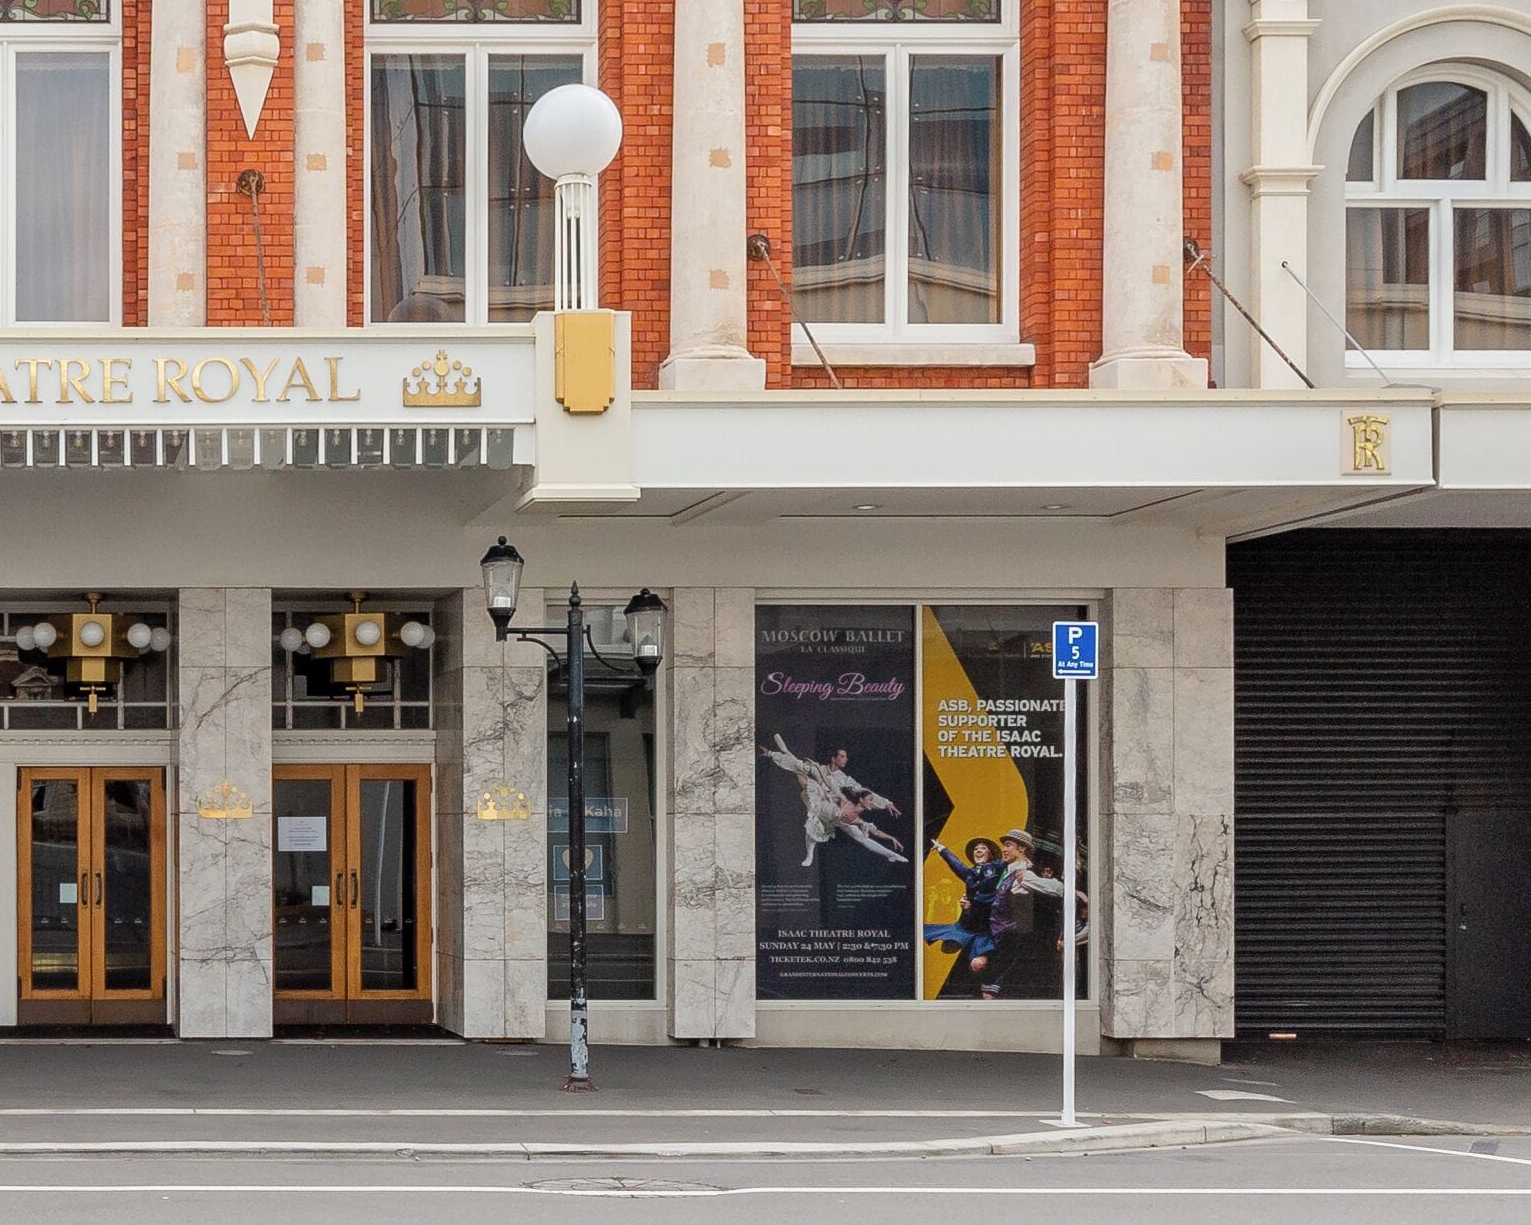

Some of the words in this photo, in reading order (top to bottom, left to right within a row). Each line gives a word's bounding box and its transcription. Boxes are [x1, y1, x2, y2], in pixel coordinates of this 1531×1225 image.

[152, 356, 361, 404] ROYAL
[762, 629, 838, 643] MOSCOW
[845, 629, 905, 643] BALLET
[1068, 626, 1083, 645] P
[800, 645, 813, 653] LA
[1071, 646, 1080, 660] 5
[1057, 660, 1065, 668] At
[1067, 660, 1078, 669] Any
[1079, 660, 1093, 668] Time
[760, 672, 834, 701] Sleeping
[836, 672, 905, 701] Beauty
[938, 699, 972, 713] ASB,
[938, 715, 1027, 727] SUPPORTER
[938, 730, 958, 742] OF
[962, 730, 991, 742] THE
[996, 730, 1042, 742] ISAAC
[938, 745, 1006, 758] THEATRE
[1010, 745, 1063, 758] ROYAL.
[584, 805, 622, 818] Kaha
[778, 929, 808, 938] ISAAC
[808, 929, 856, 938] THEATRE
[857, 929, 891, 938] ROYAL
[759, 941, 800, 950] SUNDAY
[814, 941, 836, 950] MAY
[894, 941, 909, 950] PM
